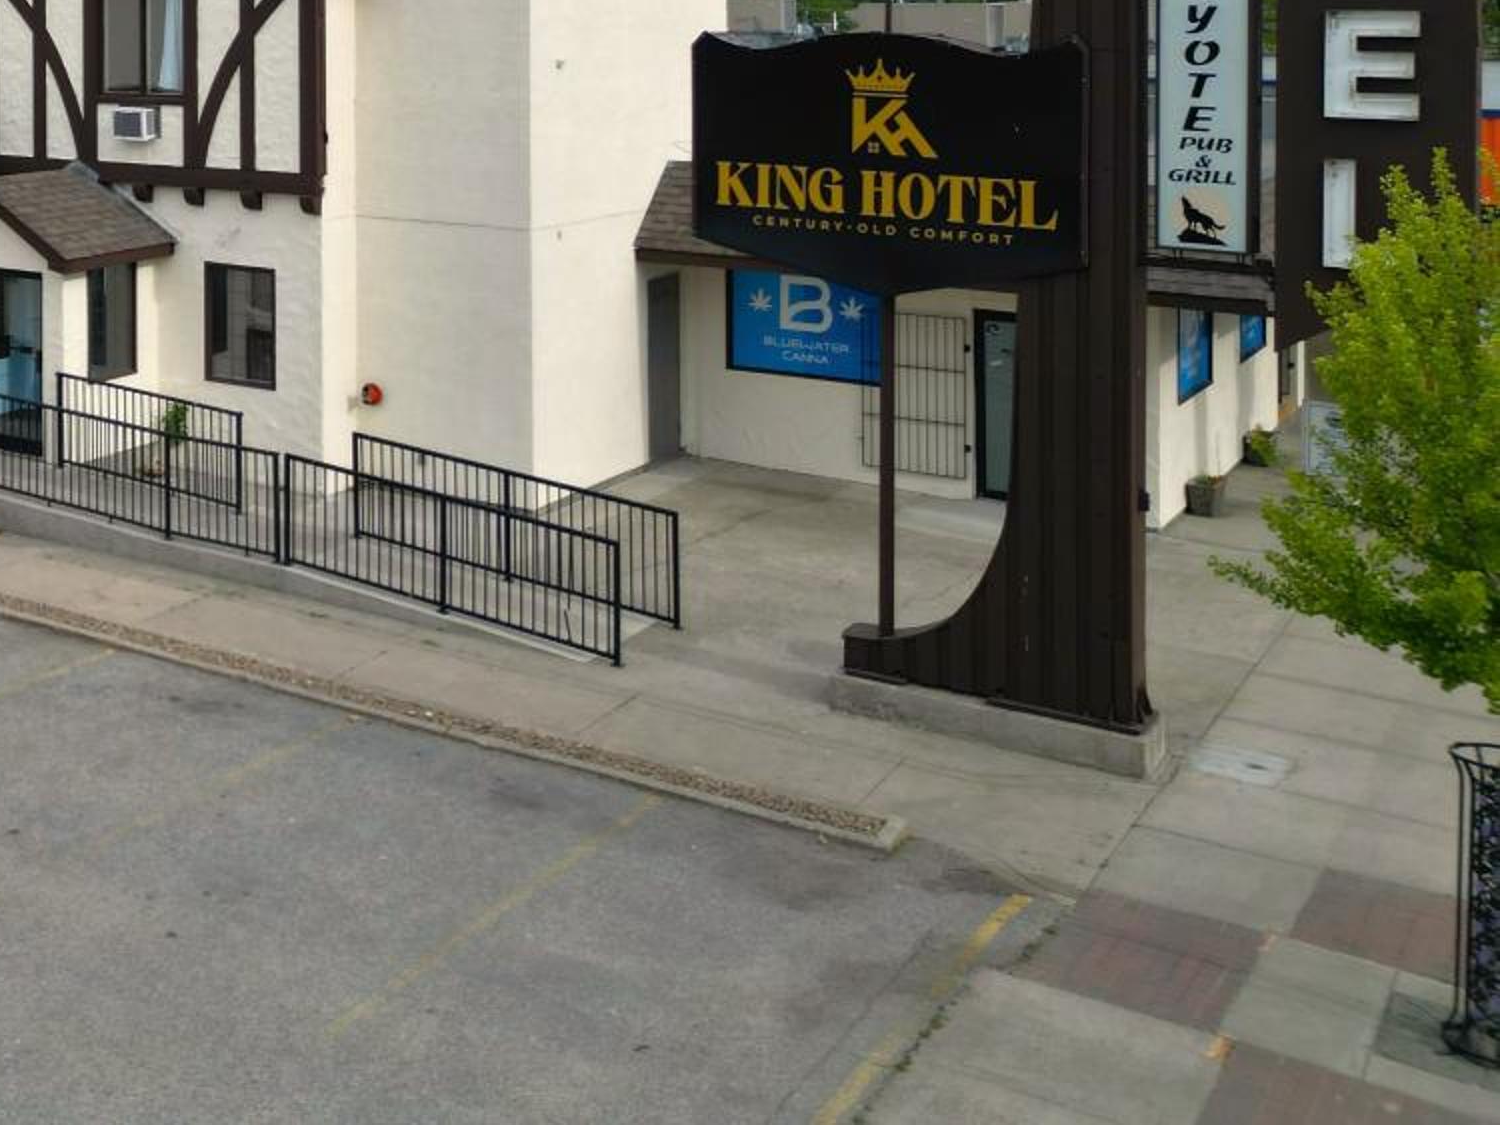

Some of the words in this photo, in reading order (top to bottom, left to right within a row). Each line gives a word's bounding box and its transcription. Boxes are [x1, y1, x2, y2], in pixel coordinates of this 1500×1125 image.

[1178, 136, 1234, 154] PUB
[1194, 154, 1211, 169] &
[1168, 168, 1237, 186] GRILL
[716, 162, 844, 213] KING
[861, 171, 1058, 230] HOTEL
[909, 227, 1015, 247] COMFORT
[779, 274, 833, 335] B
